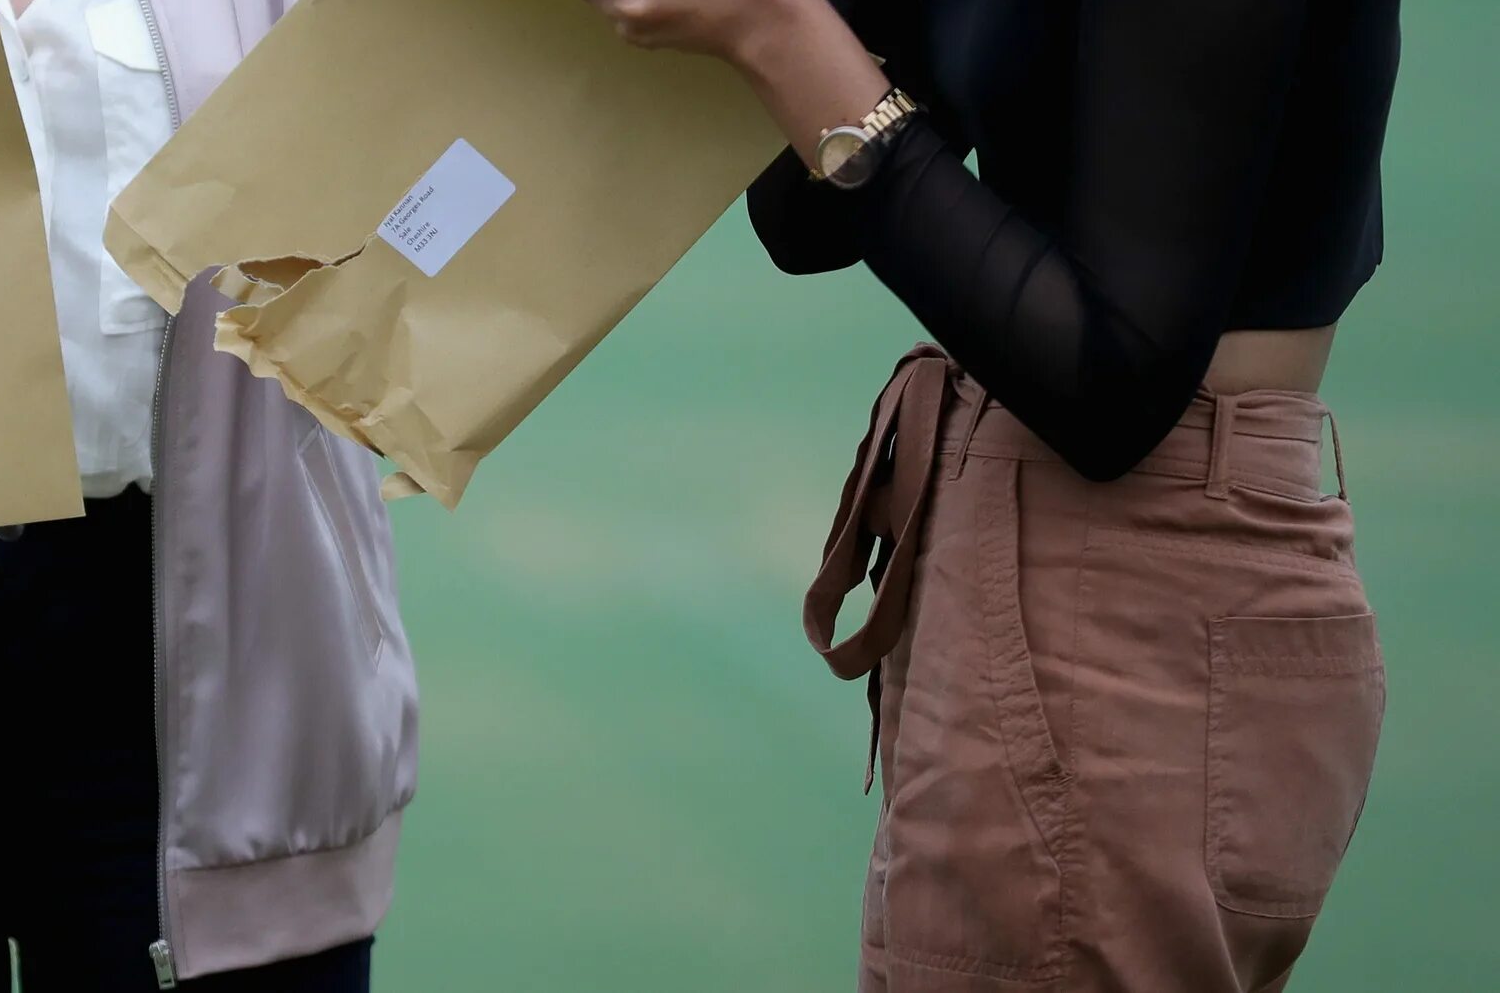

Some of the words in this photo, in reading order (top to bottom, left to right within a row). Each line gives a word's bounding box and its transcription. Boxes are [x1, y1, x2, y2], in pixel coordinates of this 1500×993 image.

[399, 201, 421, 225] Georges
[419, 185, 435, 202] Road
[398, 227, 412, 240] Sale
[406, 222, 431, 246] Cheshire
